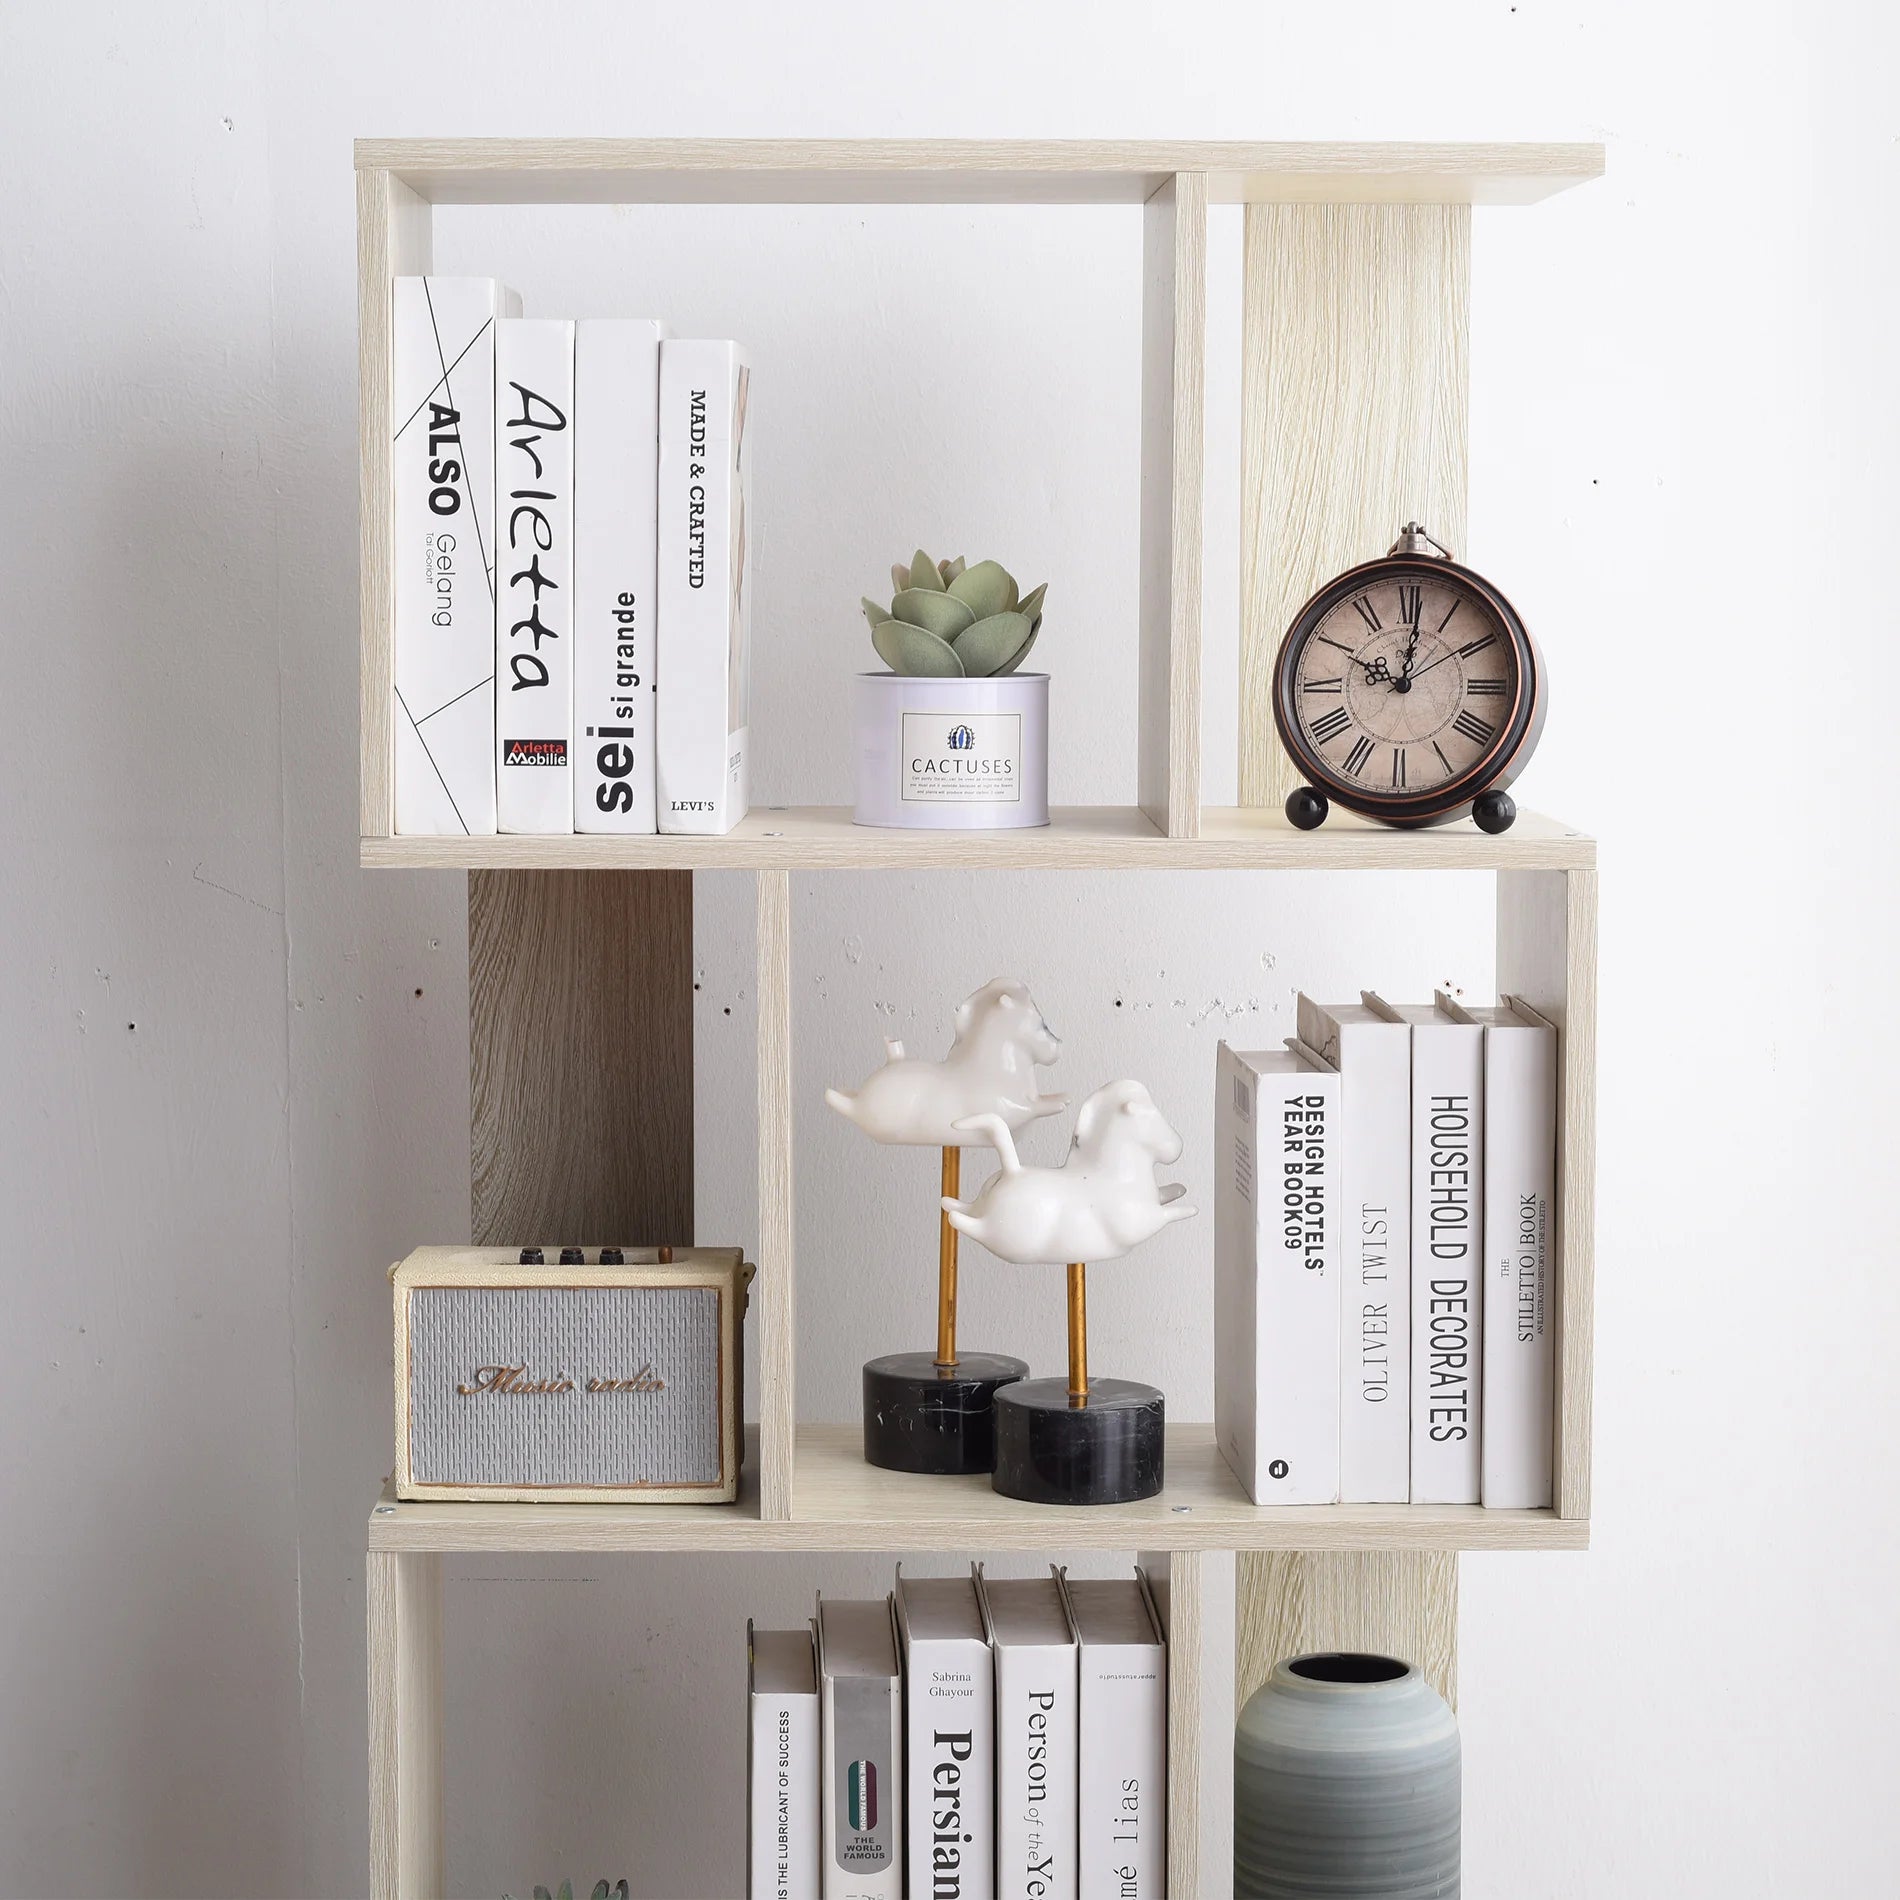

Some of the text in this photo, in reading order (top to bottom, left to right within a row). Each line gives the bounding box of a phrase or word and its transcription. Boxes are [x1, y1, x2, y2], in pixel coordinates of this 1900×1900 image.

[428, 401, 461, 516] ALSO
[689, 390, 706, 588] MADE & CRAFTED
[506, 382, 566, 691] Arletta
[432, 533, 456, 627] Gelang
[586, 592, 640, 813] sei si grande
[506, 753, 566, 765] Mobilie
[511, 741, 565, 753] Arletta
[912, 759, 1011, 773] CACTUSES
[672, 801, 714, 811] LEVI'S
[1284, 1095, 1303, 1152] YEAR
[1305, 1096, 1324, 1175] DESIGN
[1430, 1096, 1468, 1441] HOUSEHOLD DECORATES
[1501, 1259, 1509, 1277] THE
[1518, 1193, 1536, 1343] STILETTO BOOK
[1362, 1203, 1388, 1402] OLIVER TWIST
[457, 1362, 666, 1396] Music radio
[930, 1687, 974, 1699] Ghayour
[933, 1672, 971, 1681] Sabrina
[1028, 1689, 1054, 1803] Person
[778, 1711, 789, 1899] IS THE LUBRICANT OF SUCCESS
[933, 1729, 972, 1900] Persian
[1024, 1808, 1044, 1826] of
[1027, 1855, 1053, 1900] Ye
[1112, 1866, 1138, 1900] mé
